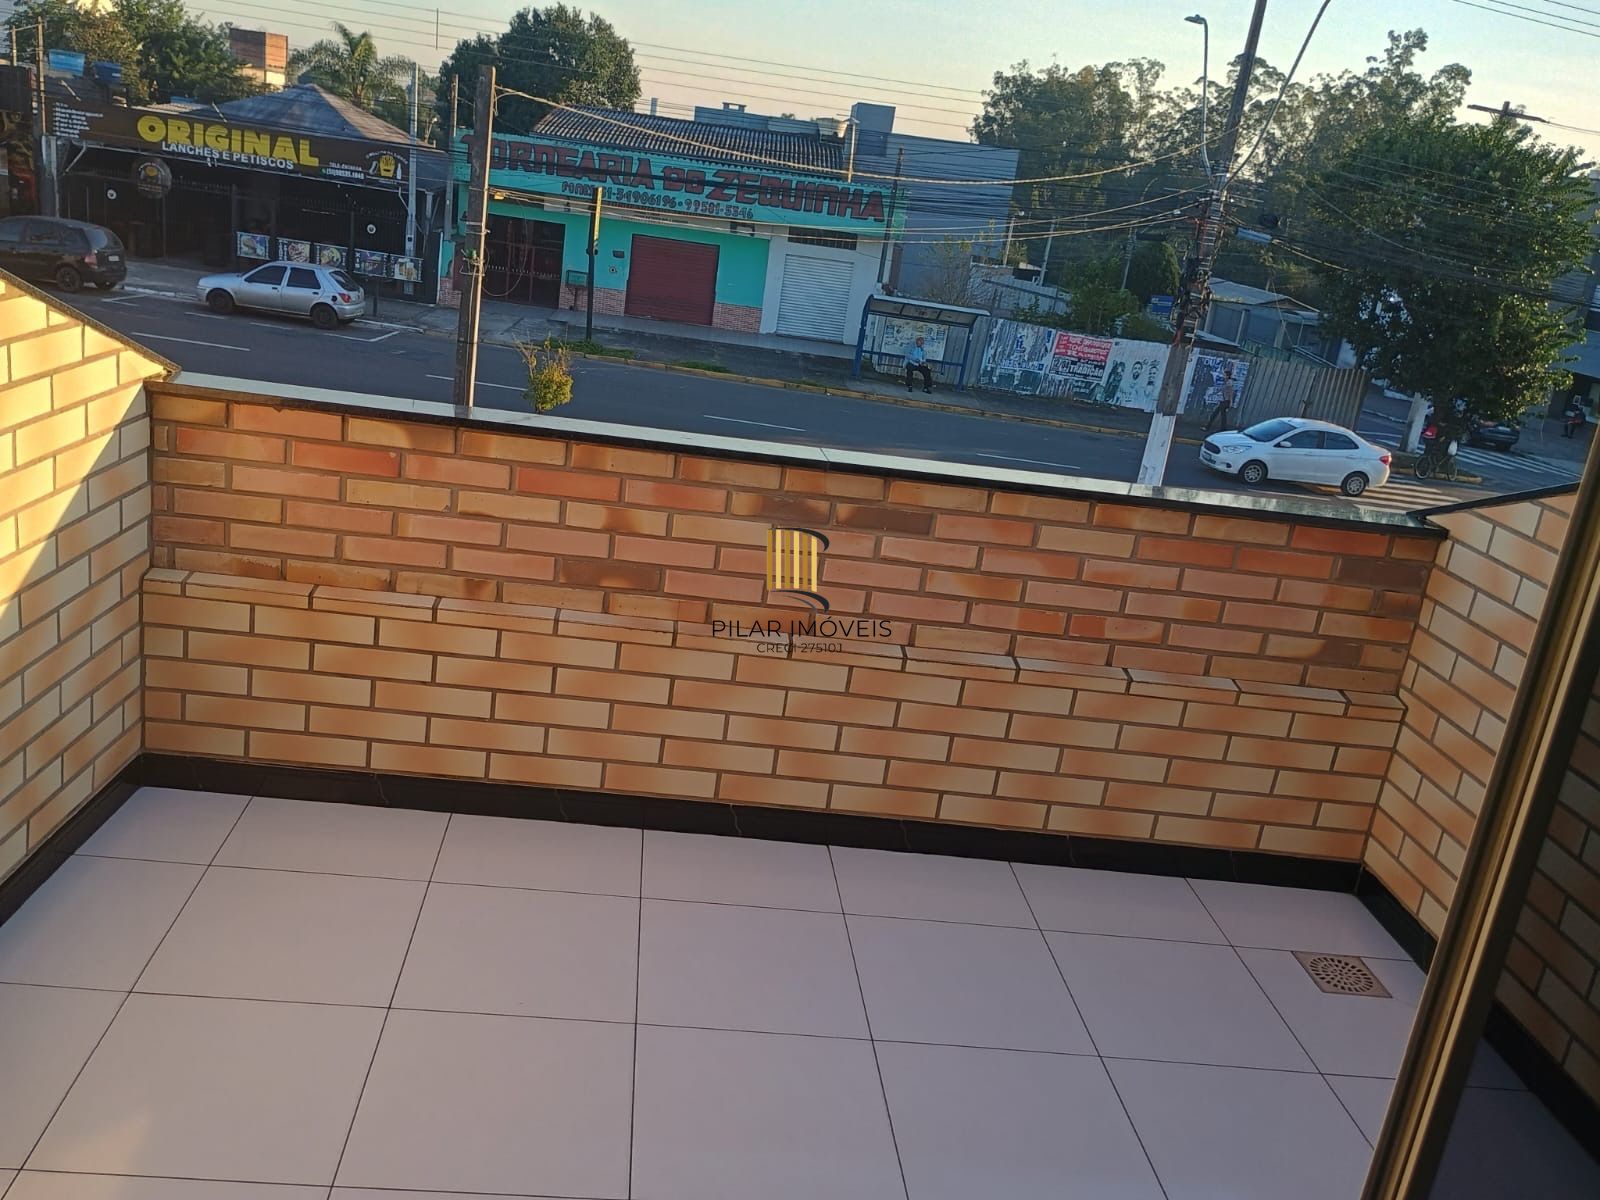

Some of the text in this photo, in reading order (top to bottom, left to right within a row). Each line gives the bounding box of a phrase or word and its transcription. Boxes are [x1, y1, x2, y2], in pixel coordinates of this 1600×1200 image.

[137, 115, 319, 166] ORIGINAL
[162, 141, 294, 170] LANCHES E PETISCOS
[706, 169, 885, 222] ZEQUINHA
